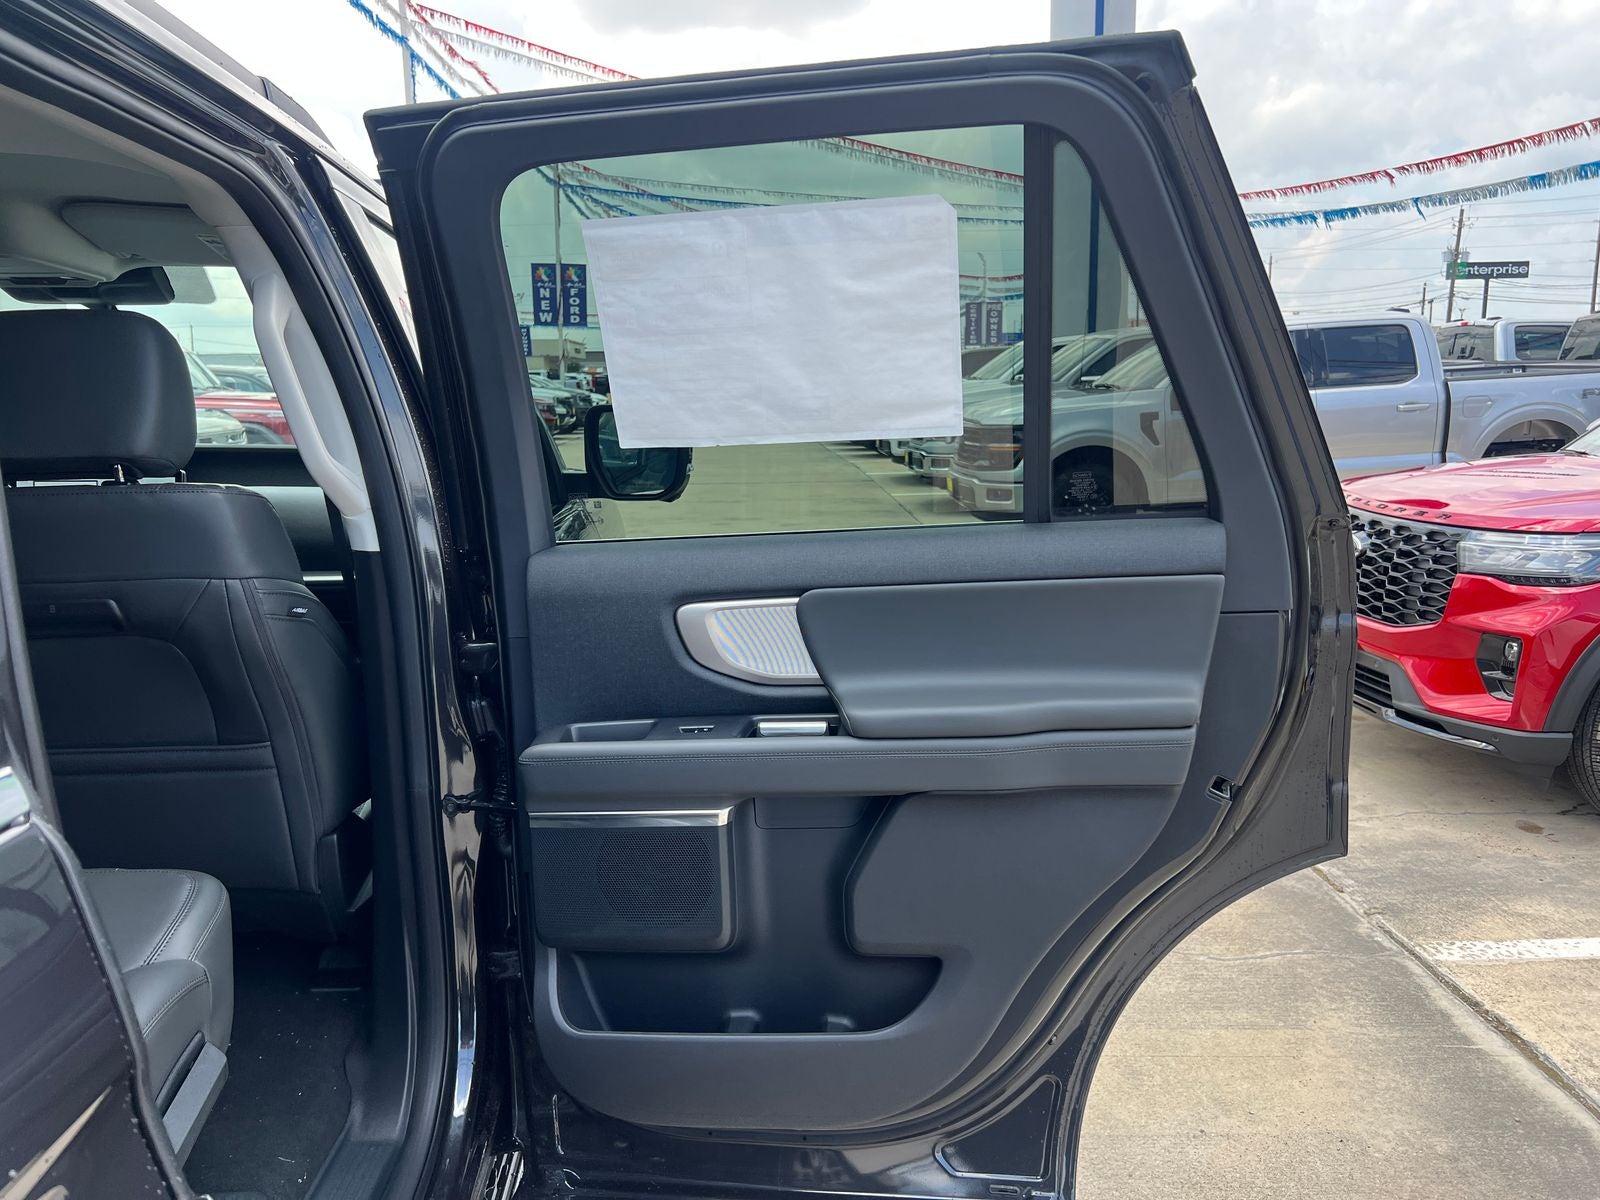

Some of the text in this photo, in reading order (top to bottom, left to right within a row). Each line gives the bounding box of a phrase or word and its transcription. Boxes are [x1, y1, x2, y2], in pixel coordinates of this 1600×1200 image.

[1456, 263, 1528, 277] enterprise
[539, 288, 553, 323] NEW
[569, 288, 580, 323] FORD
[1346, 494, 1452, 520] PLORER
